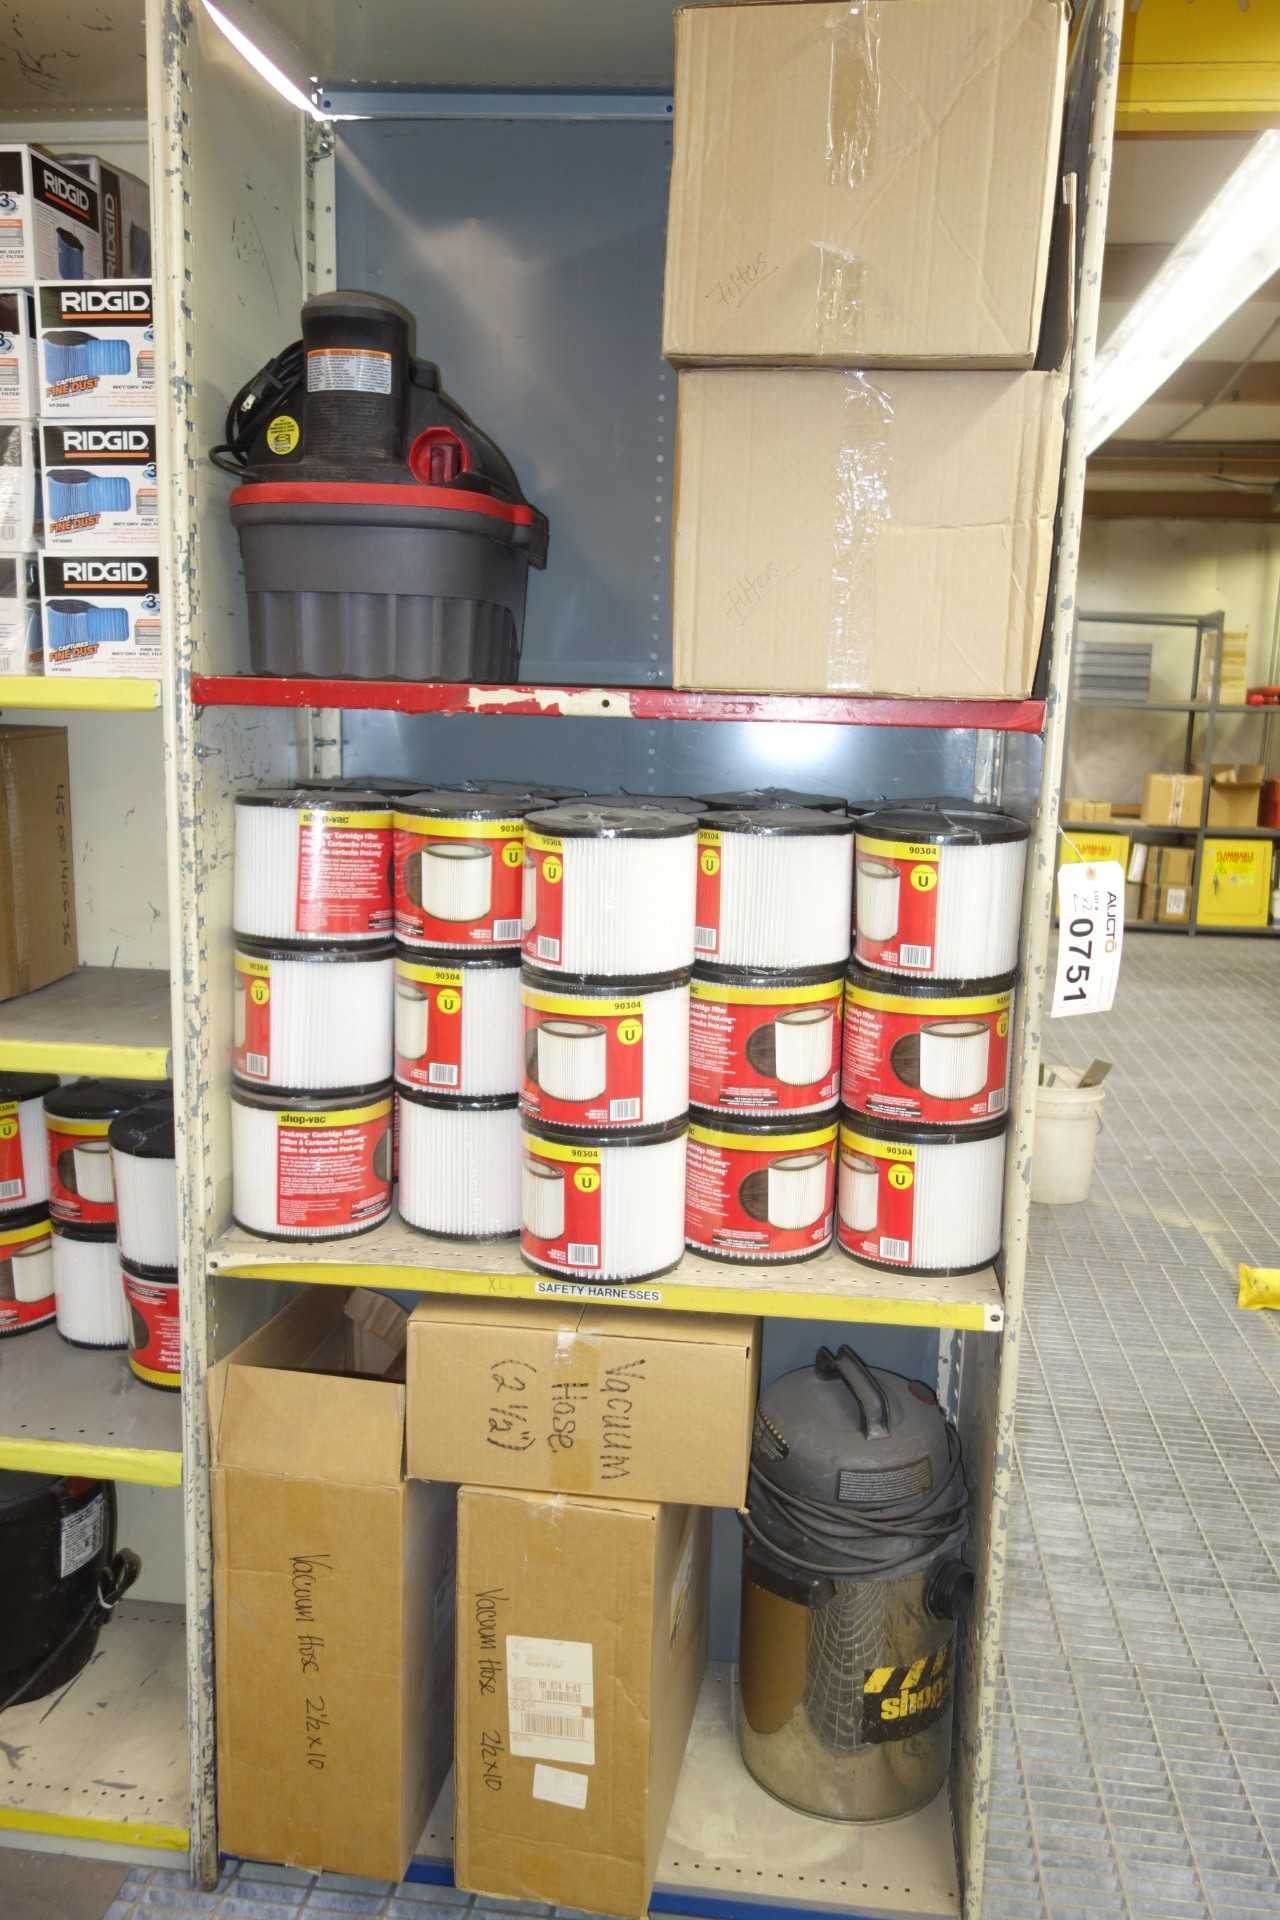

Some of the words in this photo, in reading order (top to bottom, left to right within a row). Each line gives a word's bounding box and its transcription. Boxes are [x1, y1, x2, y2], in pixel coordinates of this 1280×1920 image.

[43, 168, 90, 211] RIDGID
[61, 292, 150, 312] RIDGID
[63, 431, 149, 450] RIDGID
[63, 562, 148, 582] RIDGID
[908, 846, 937, 855] 90304
[509, 853, 519, 863] U
[706, 860, 714, 872] U
[548, 867, 557, 880] U
[918, 875, 929, 887] U
[1063, 918, 1094, 1001] 0751
[435, 972, 461, 981] 90304
[255, 990, 264, 1001] U
[444, 999, 454, 1010] U
[614, 1001, 641, 1010] 90304
[625, 1030, 636, 1041] U
[281, 1113, 326, 1125] shop-vac
[3, 1126, 12, 1136] U
[572, 1149, 599, 1158] 90304
[886, 1146, 913, 1156] 90304
[582, 1177, 592, 1188] U
[895, 1174, 906, 1185] U
[538, 1282, 585, 1296] SAFETY
[588, 1286, 660, 1301] HARNESSES
[600, 1358, 647, 1480] Vacuum
